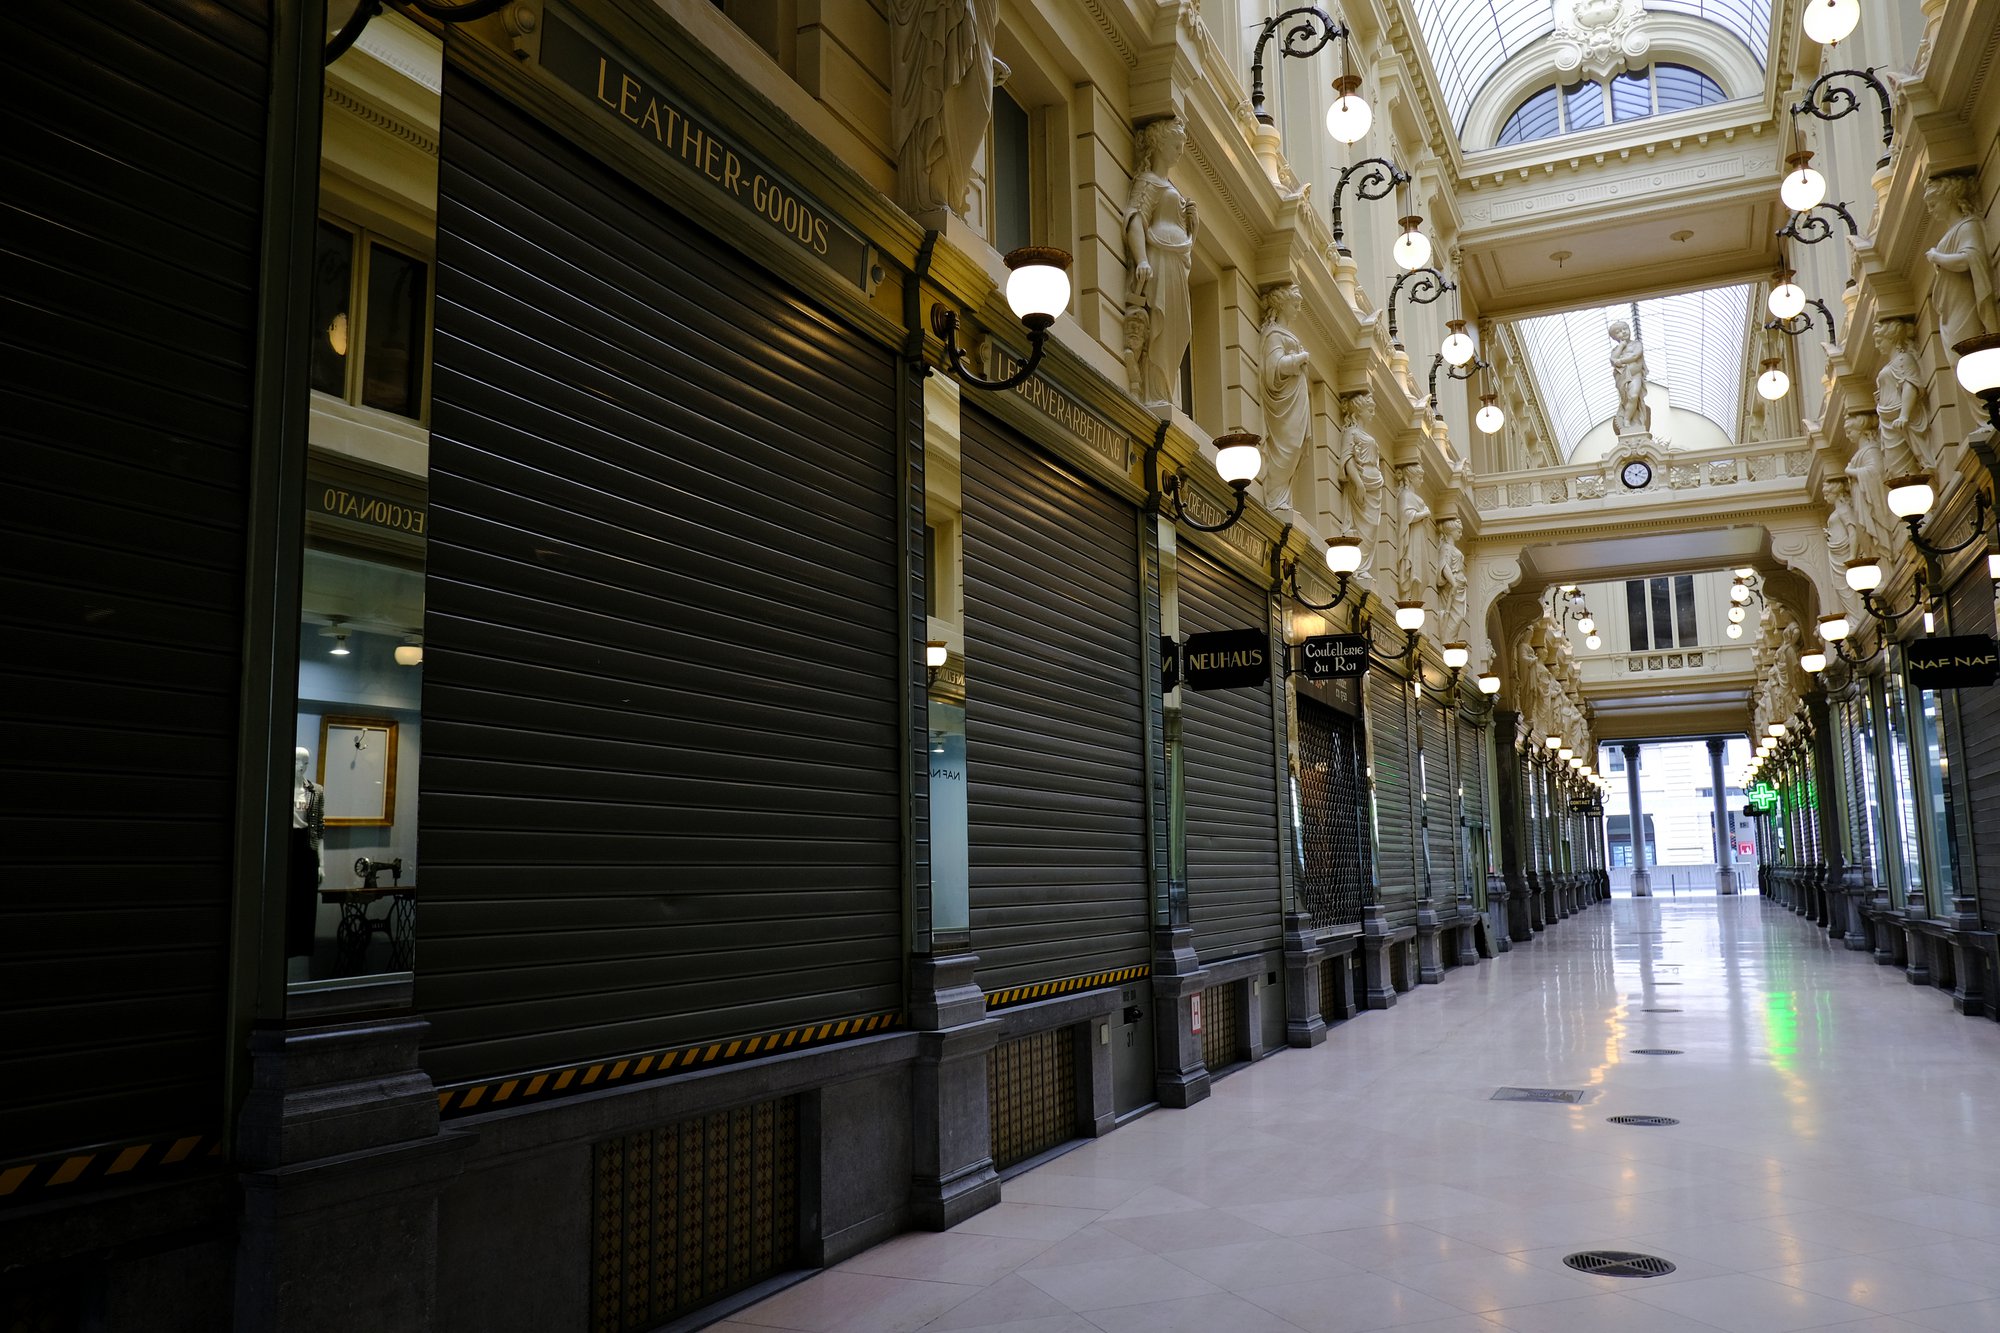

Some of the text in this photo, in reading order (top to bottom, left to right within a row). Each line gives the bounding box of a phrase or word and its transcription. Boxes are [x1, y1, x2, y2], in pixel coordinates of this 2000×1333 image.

[596, 57, 830, 255] LEATHER-GOODS
[1189, 649, 1263, 671] NEUHAUS
[1314, 659, 1329, 674] du
[1909, 655, 1997, 670] NAF NAF
